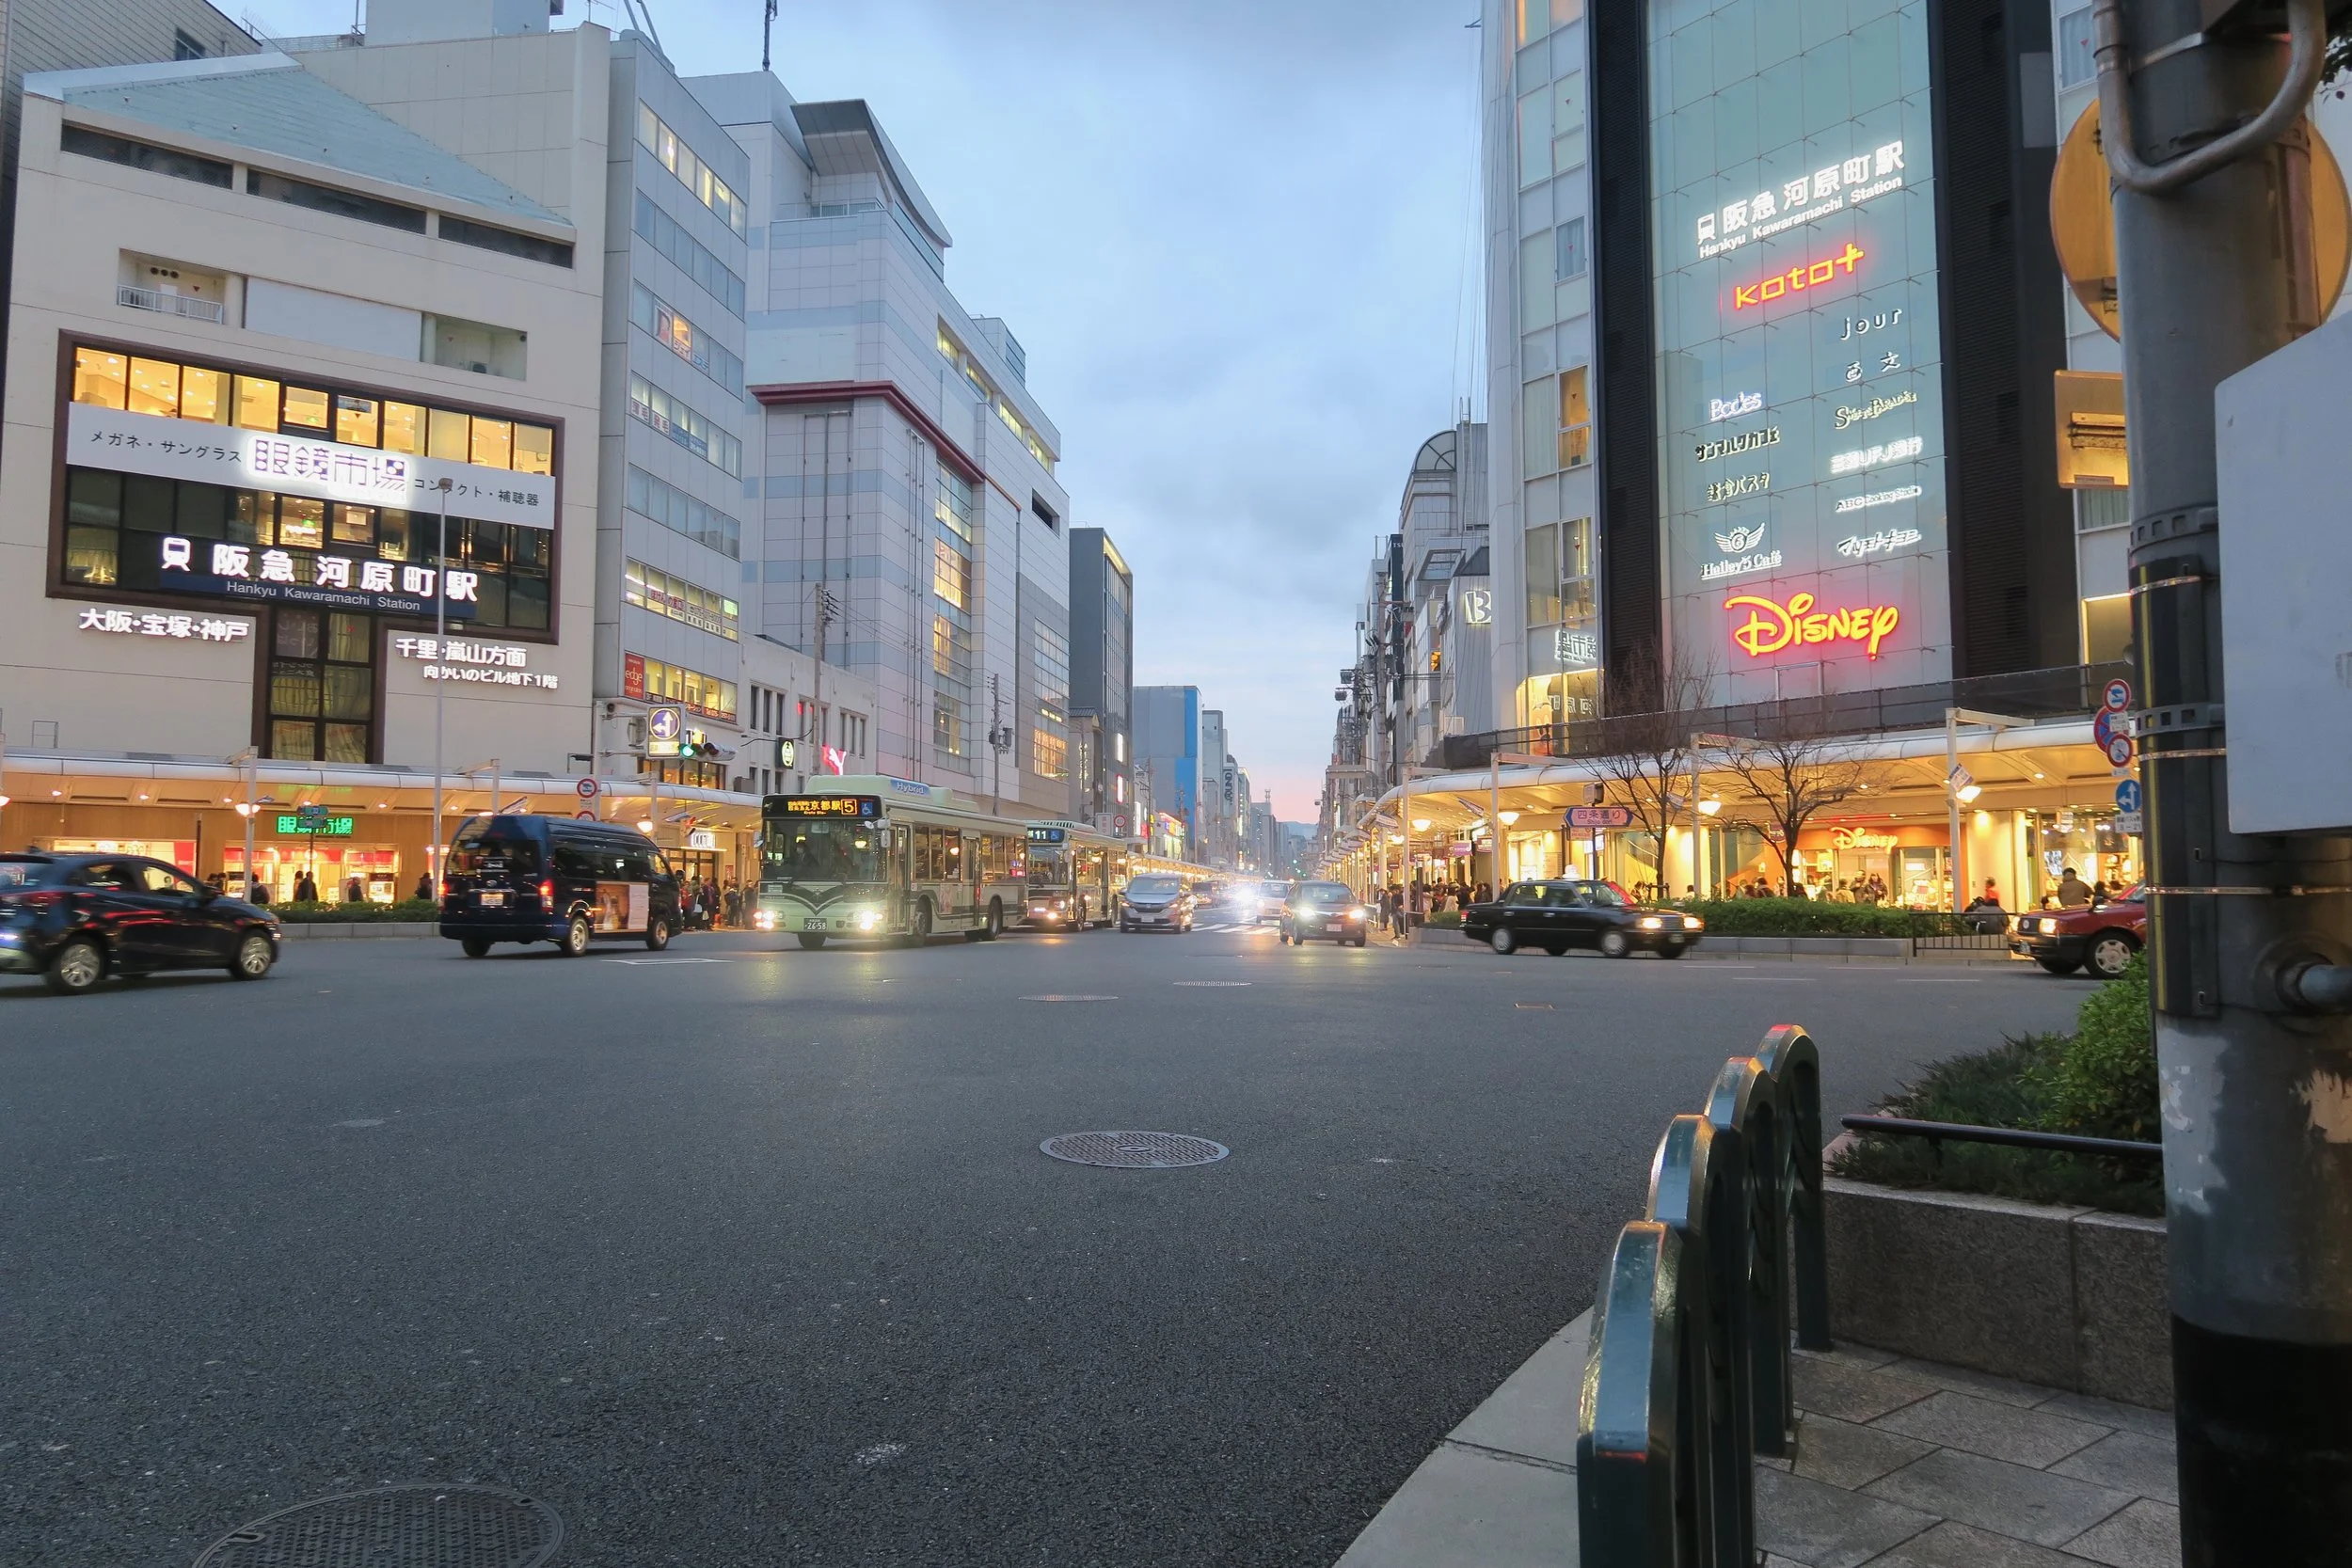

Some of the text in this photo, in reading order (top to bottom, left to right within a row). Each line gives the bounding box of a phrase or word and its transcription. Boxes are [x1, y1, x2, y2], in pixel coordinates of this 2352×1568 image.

[1699, 176, 1902, 259] Hankyu Kawaramachi Station
[90, 431, 242, 463] メガネ・サングラス
[254, 439, 406, 492] 眼鏡市場
[227, 580, 421, 611] Hankyu Kawaramachi Station
[79, 608, 249, 642] 大阪・宝塚・神戸
[395, 638, 527, 668] 千里・嵐山方面
[423, 665, 558, 689] 向かいのビル地下1階
[897, 782, 925, 795] Hybrid
[844, 800, 854, 813] 5
[1577, 809, 1621, 819] 四条通り
[1034, 830, 1046, 840] 11
